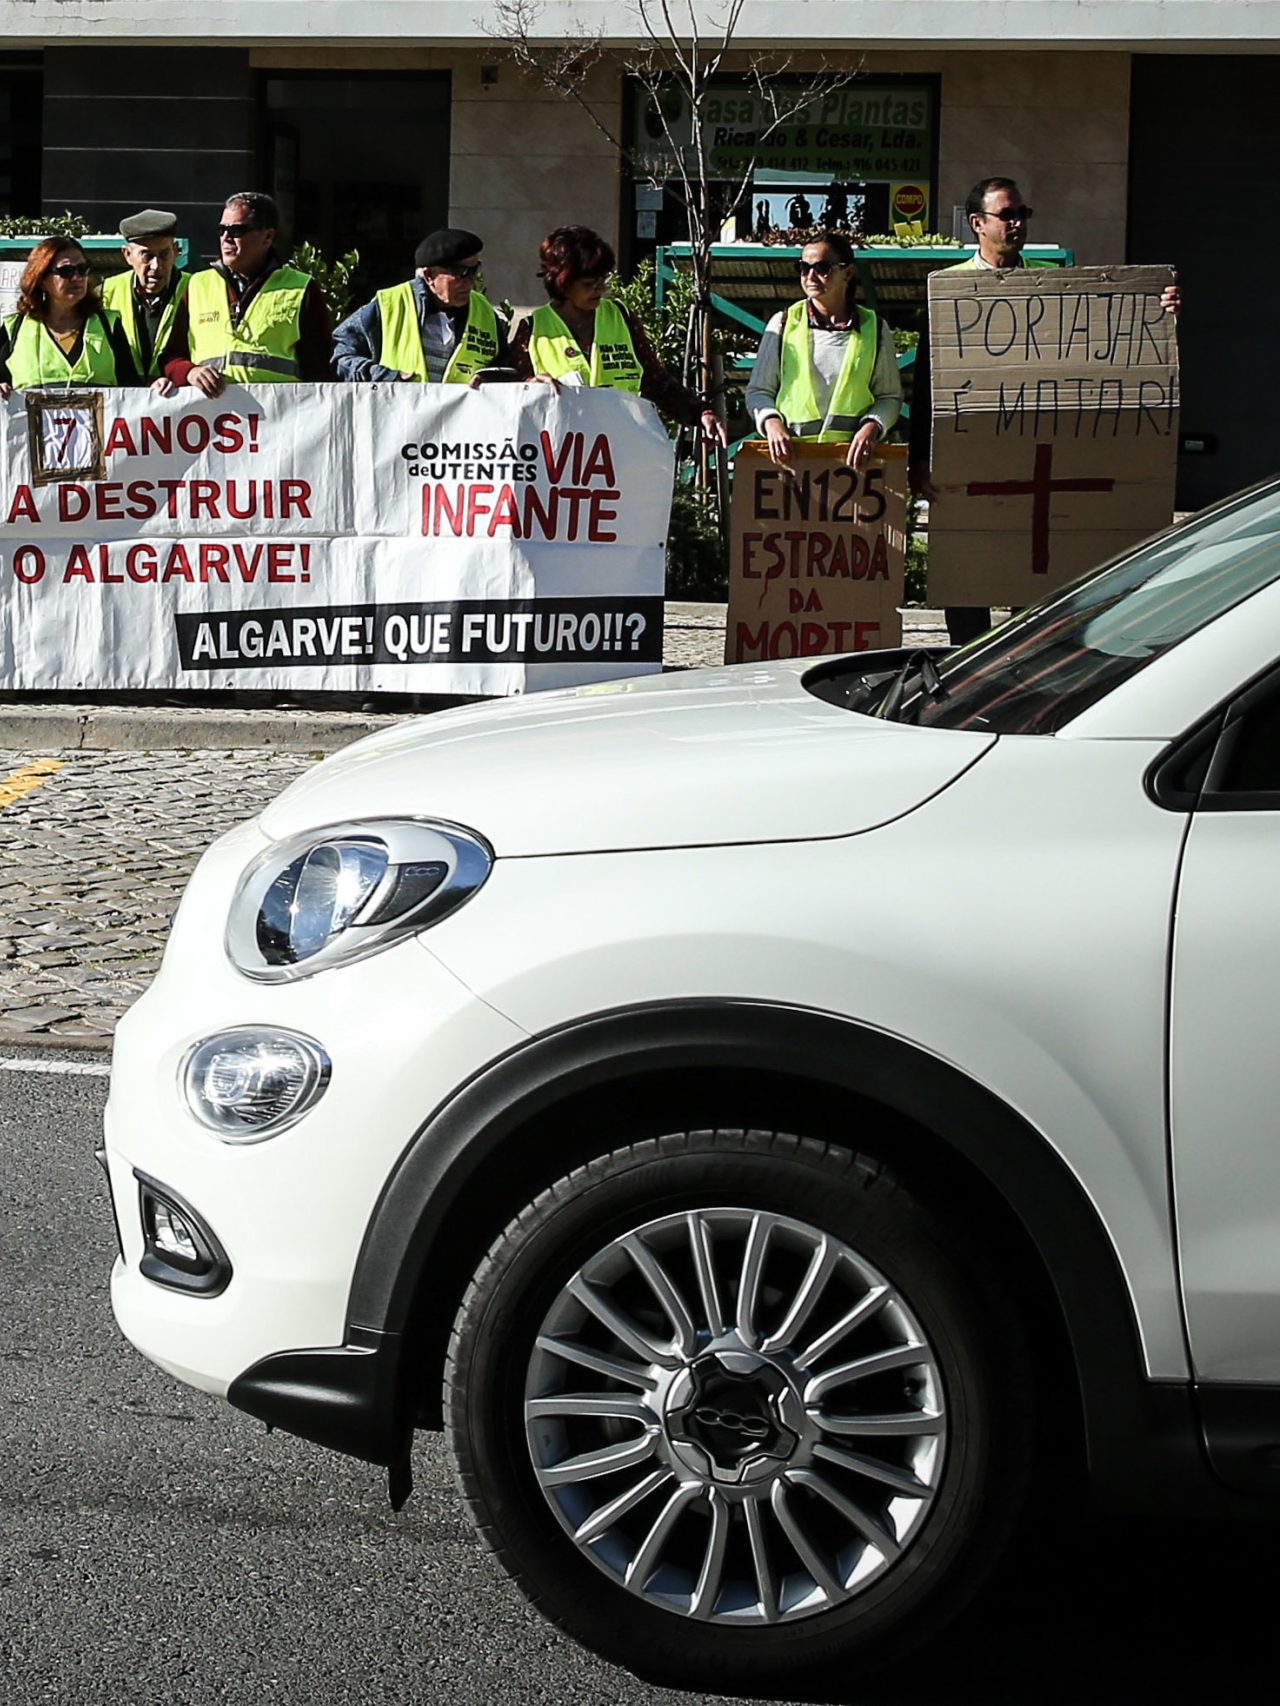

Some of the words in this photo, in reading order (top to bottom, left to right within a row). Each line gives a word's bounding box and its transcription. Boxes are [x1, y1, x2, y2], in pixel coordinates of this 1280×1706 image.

[704, 98, 754, 124] asa
[818, 92, 925, 127] Plantas
[714, 127, 786, 147] Ricado
[795, 128, 808, 147] &
[816, 128, 872, 153] Cesar,
[881, 129, 921, 149] Lda.
[895, 193, 922, 205] COMPO
[953, 292, 1167, 368] PORTAJAR
[954, 379, 972, 433] É
[996, 376, 1175, 438] MATAR!
[53, 418, 77, 463] 7
[104, 412, 259, 457] ANOS!
[401, 437, 539, 462] COMISSÃO
[540, 430, 616, 488] VIA
[6, 484, 41, 524] A
[58, 479, 312, 523] DESTRUIR
[421, 482, 621, 543] INFANTE
[754, 466, 887, 523] EN125
[12, 543, 46, 584] O
[62, 543, 312, 584] ALGARVE!
[742, 531, 890, 582] ESTRADA
[789, 588, 824, 613] DA
[191, 616, 374, 661] ALGARVE!
[384, 614, 451, 662] QUE
[461, 612, 647, 655] FUTURO!!?
